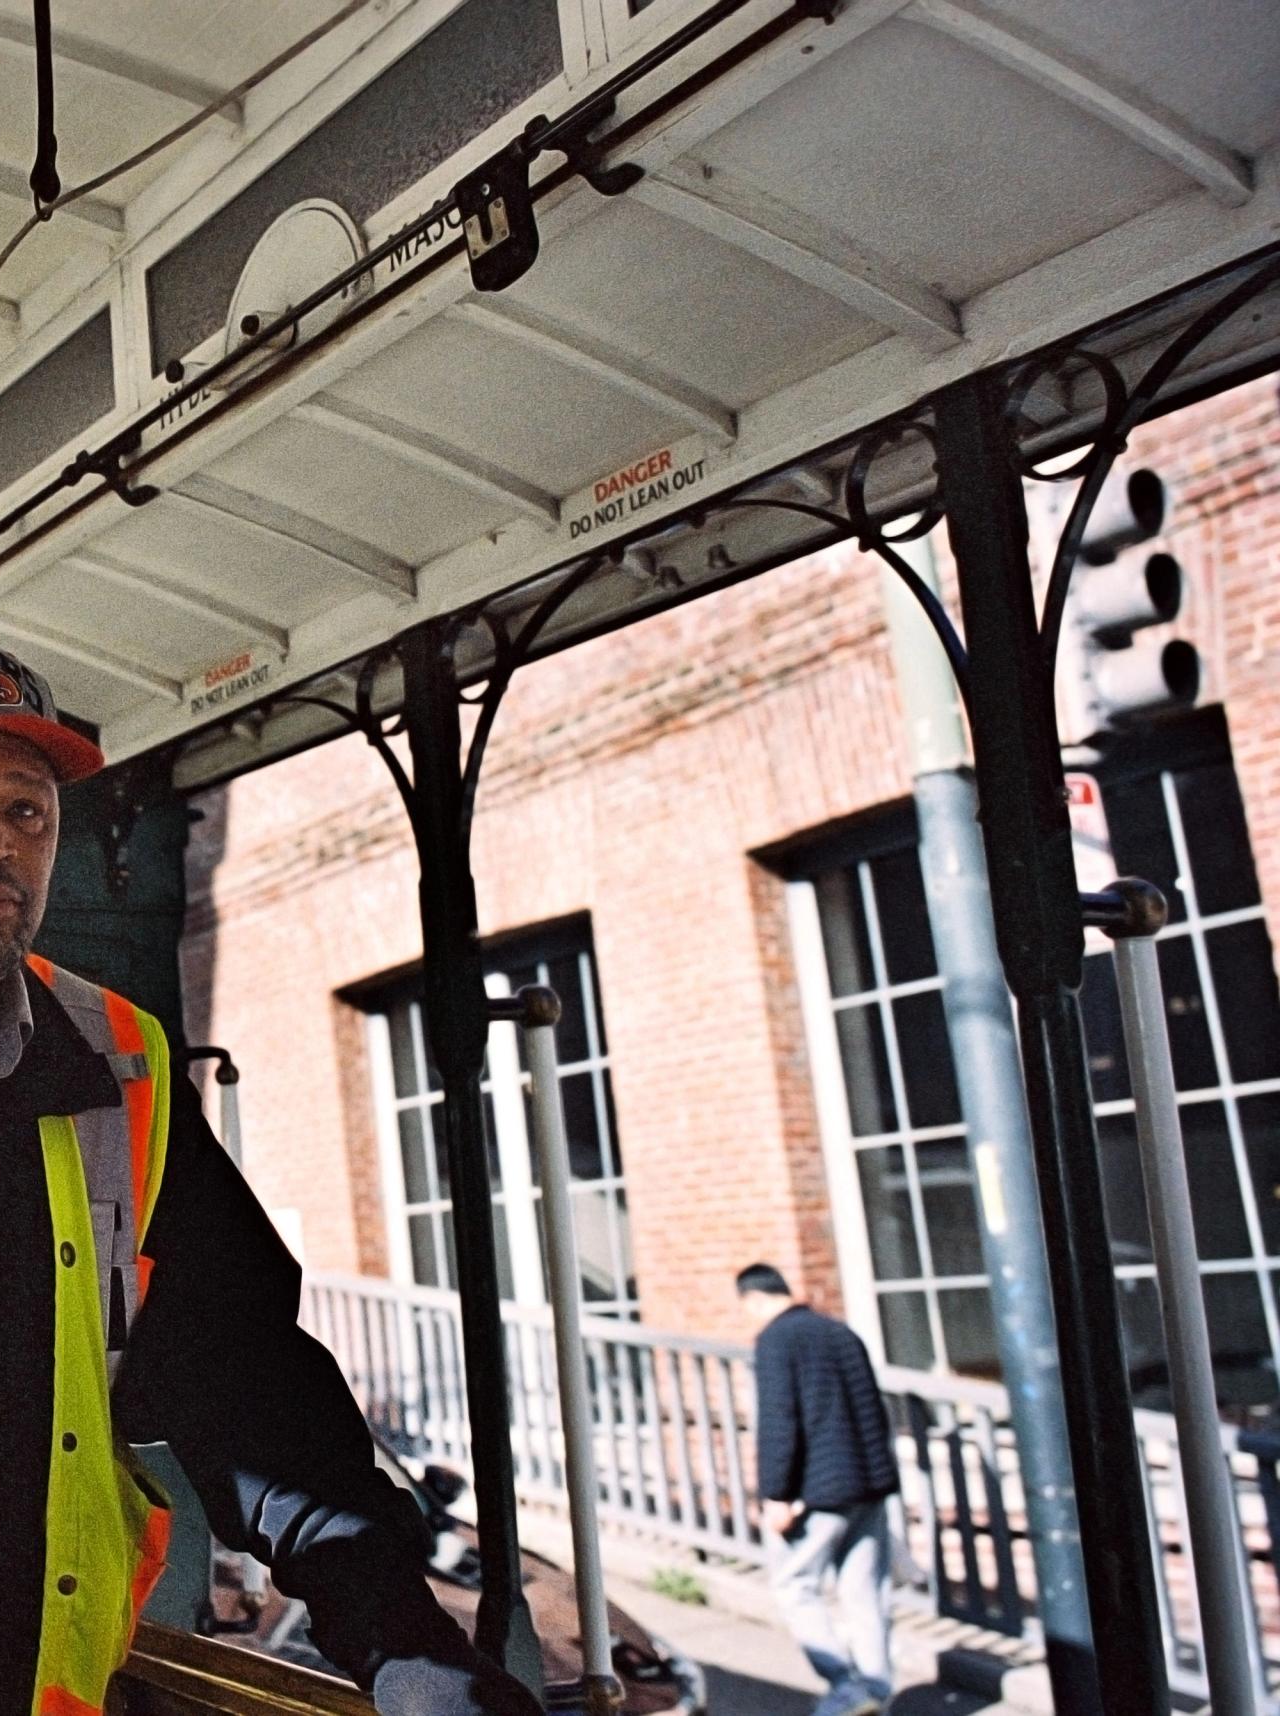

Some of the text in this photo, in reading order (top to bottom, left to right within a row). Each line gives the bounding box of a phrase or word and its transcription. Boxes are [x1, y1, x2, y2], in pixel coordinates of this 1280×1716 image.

[570, 460, 704, 539] DO NOT LEAN OUT
[594, 450, 671, 502] DANGER
